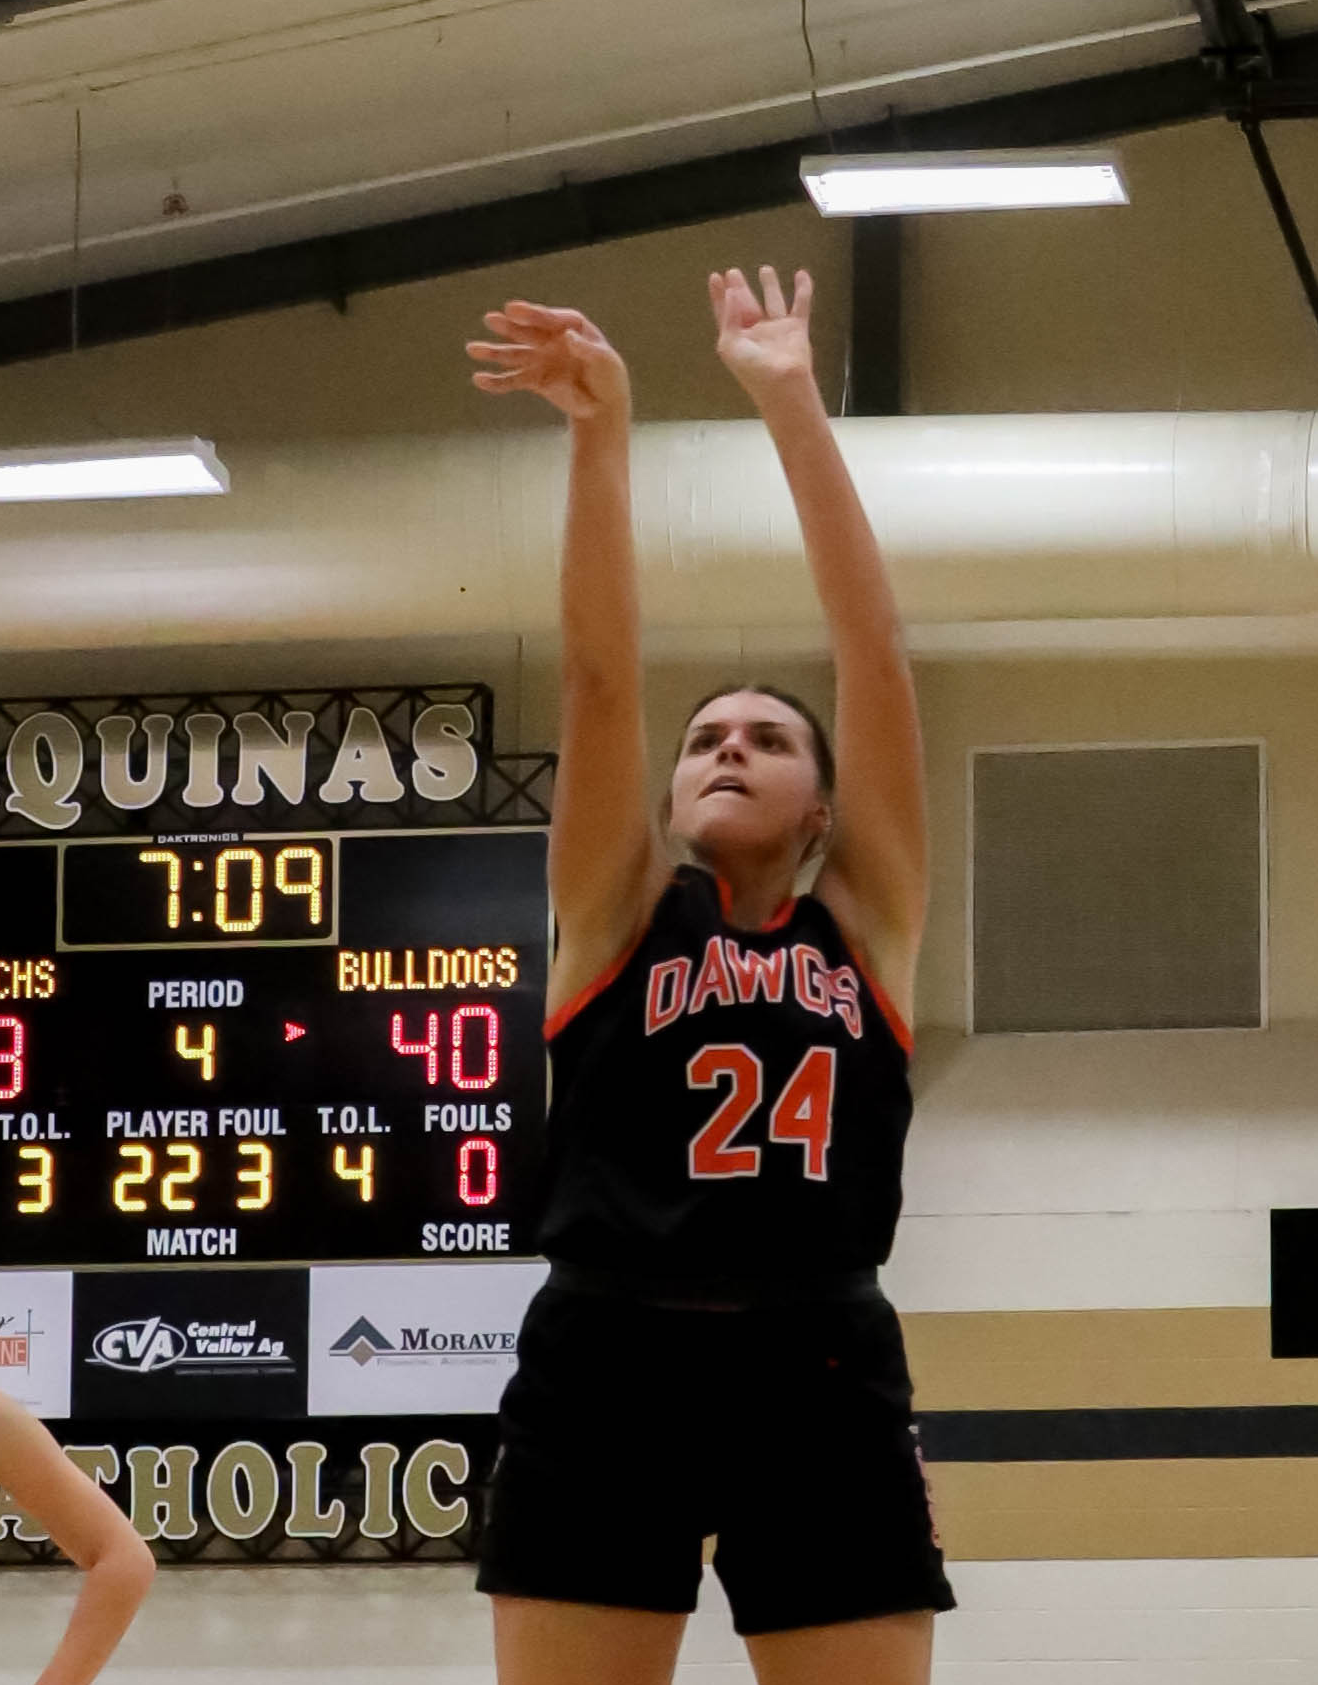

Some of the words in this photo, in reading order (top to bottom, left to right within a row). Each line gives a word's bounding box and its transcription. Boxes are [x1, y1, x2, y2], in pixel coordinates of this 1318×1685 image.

[158, 833, 240, 844] DAKTRONICS
[138, 847, 323, 932] 7:09
[147, 979, 244, 1009] PERIOD
[338, 947, 518, 992] BULLDOGS
[645, 935, 863, 1040] DAWGS
[175, 1023, 216, 1082] 4
[391, 1005, 499, 1090] 40
[106, 1110, 208, 1139] PLAYER
[218, 1108, 287, 1137] FOUL
[317, 1106, 391, 1135] T.O.L.
[424, 1103, 512, 1132] FOULS
[687, 1043, 837, 1181] 24
[17, 1145, 53, 1213] 3
[113, 1143, 202, 1212] 22
[236, 1142, 273, 1210] 3
[334, 1145, 375, 1203] 4
[458, 1139, 497, 1206] 0
[147, 1227, 237, 1256] MATCH
[421, 1222, 511, 1252] SCORE
[100, 1316, 175, 1372] CVA
[187, 1320, 257, 1338] Central
[195, 1337, 254, 1357] Valley
[257, 1337, 284, 1357] Ag
